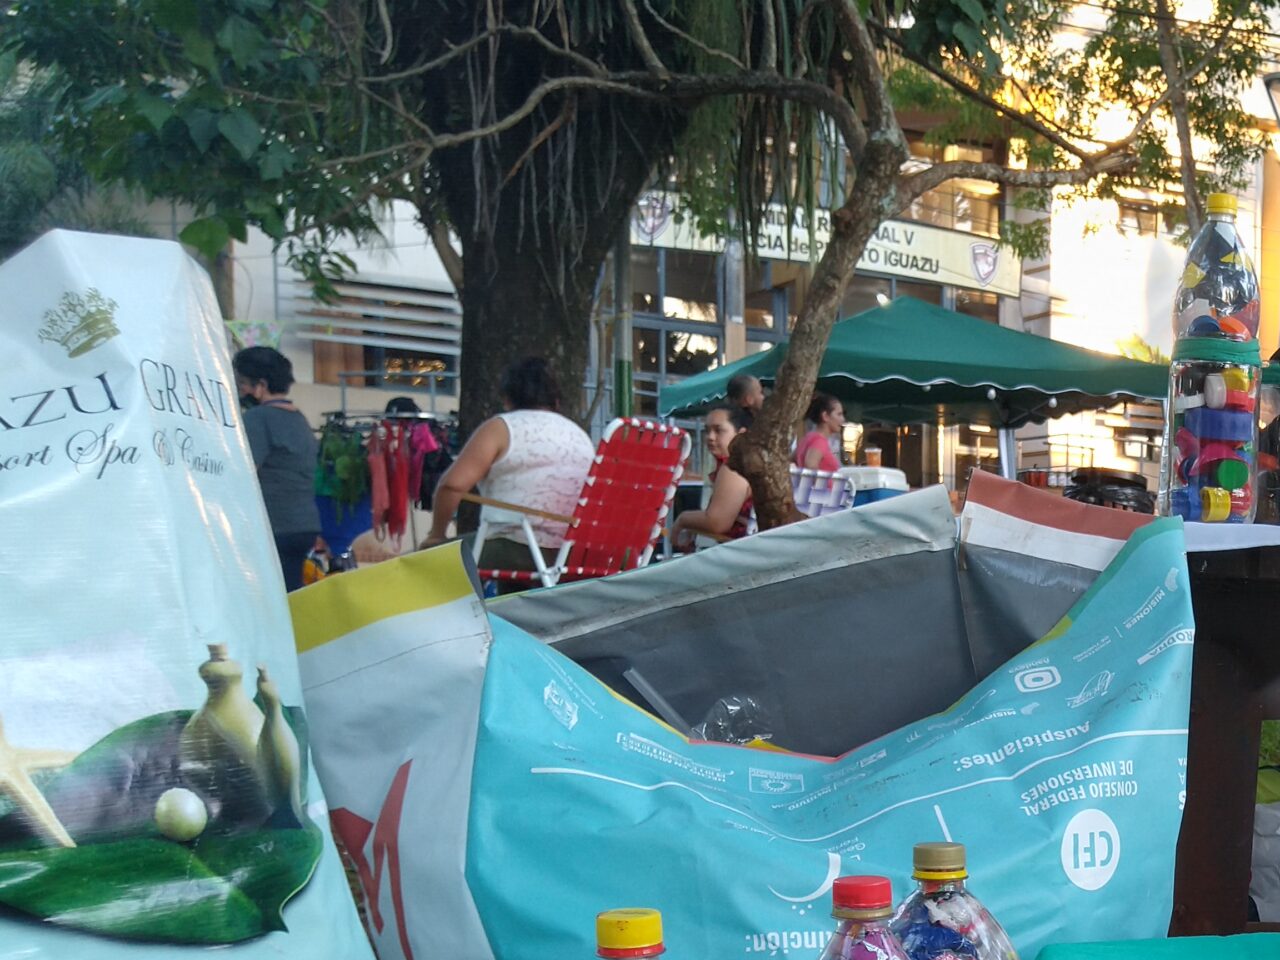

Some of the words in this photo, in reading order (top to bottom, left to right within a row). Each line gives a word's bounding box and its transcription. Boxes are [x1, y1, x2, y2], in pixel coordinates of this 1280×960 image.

[904, 231, 915, 245] V
[884, 250, 939, 274] IGUAZU
[66, 423, 141, 479] Spa
[952, 720, 1090, 773] Auspiciantes:
[1119, 759, 1133, 776] DE
[1020, 761, 1116, 803] INVERSIONES
[1089, 780, 1138, 798] CONSEJO
[1019, 787, 1086, 817] FEDERAL
[1073, 831, 1113, 869] CFI
[746, 930, 832, 956] inción:
